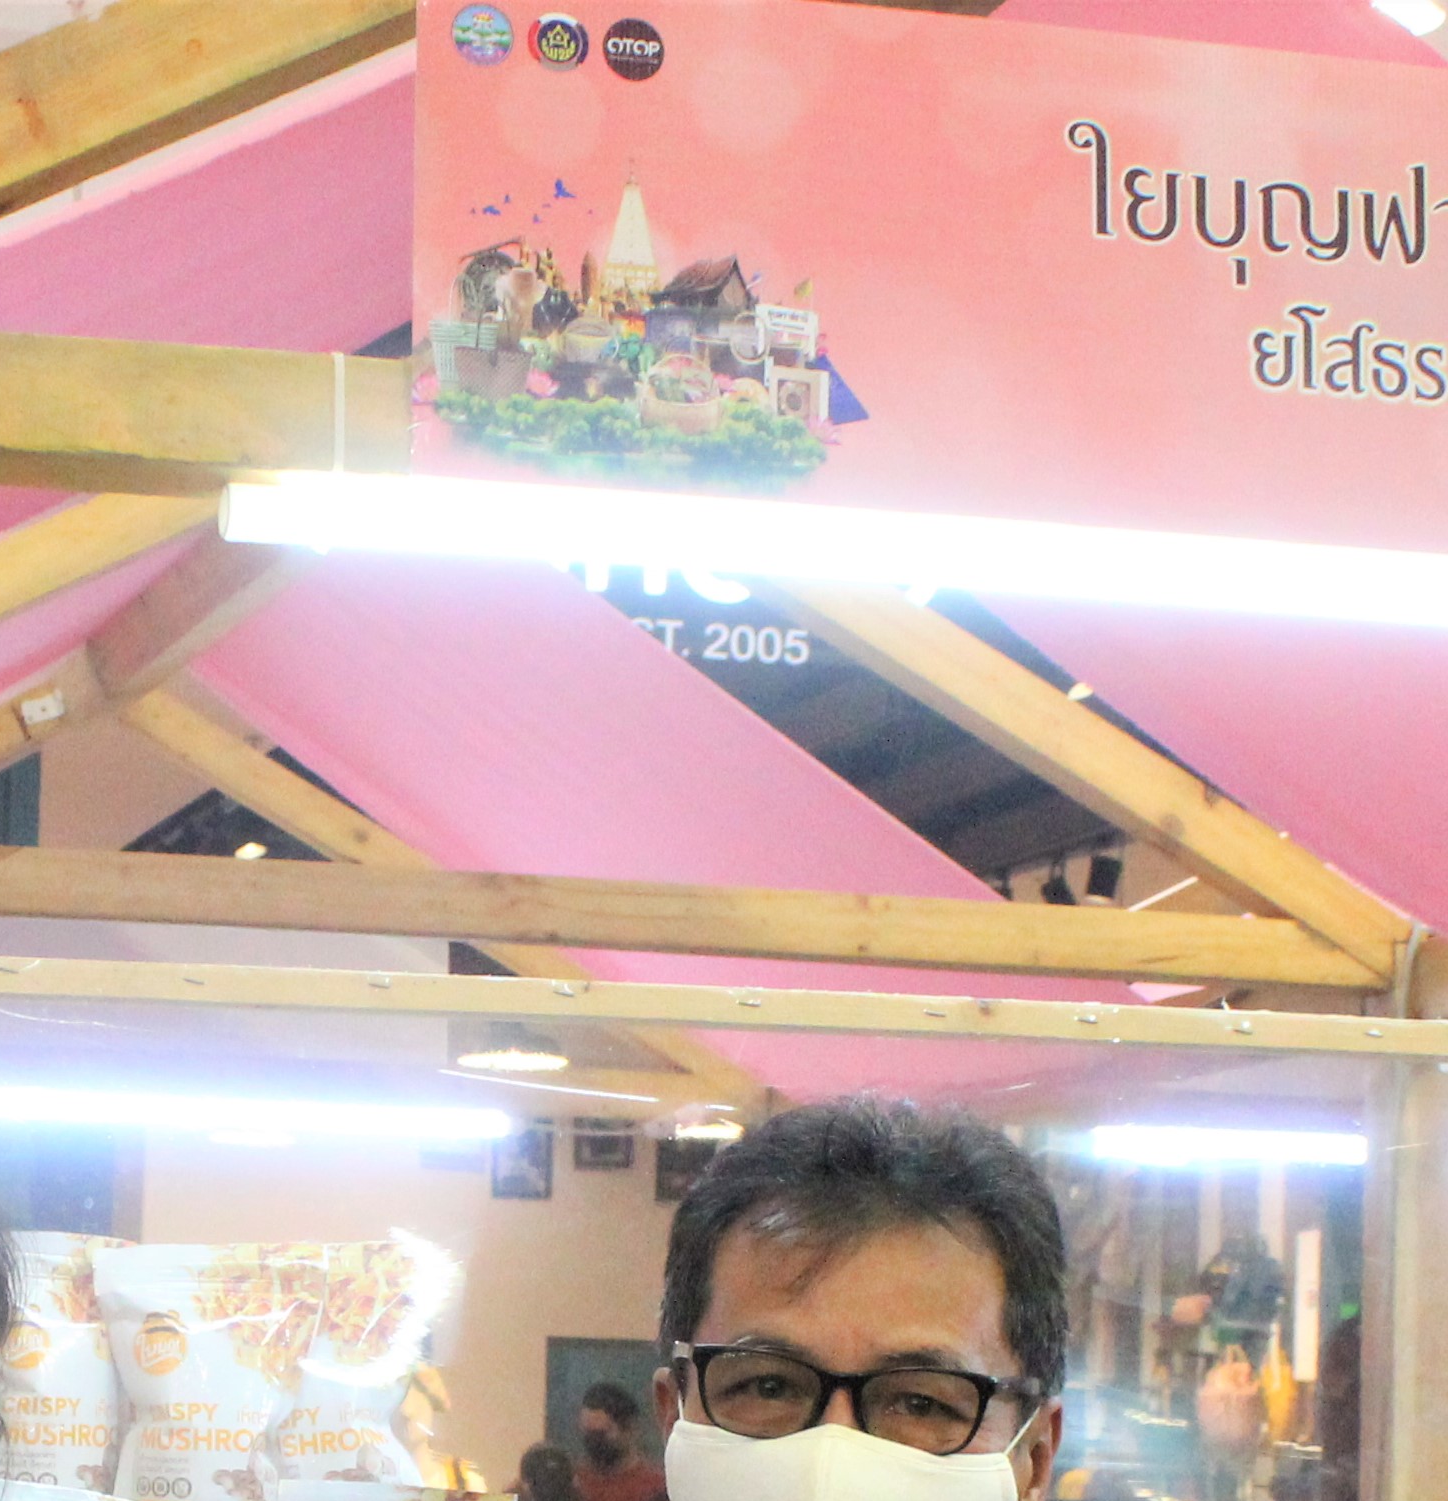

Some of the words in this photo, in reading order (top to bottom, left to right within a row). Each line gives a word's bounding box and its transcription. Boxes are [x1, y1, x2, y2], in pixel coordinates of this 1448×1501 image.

[607, 37, 660, 57] OTOP
[1252, 303, 1447, 403] ยโสธร
[703, 622, 810, 666] 2005
